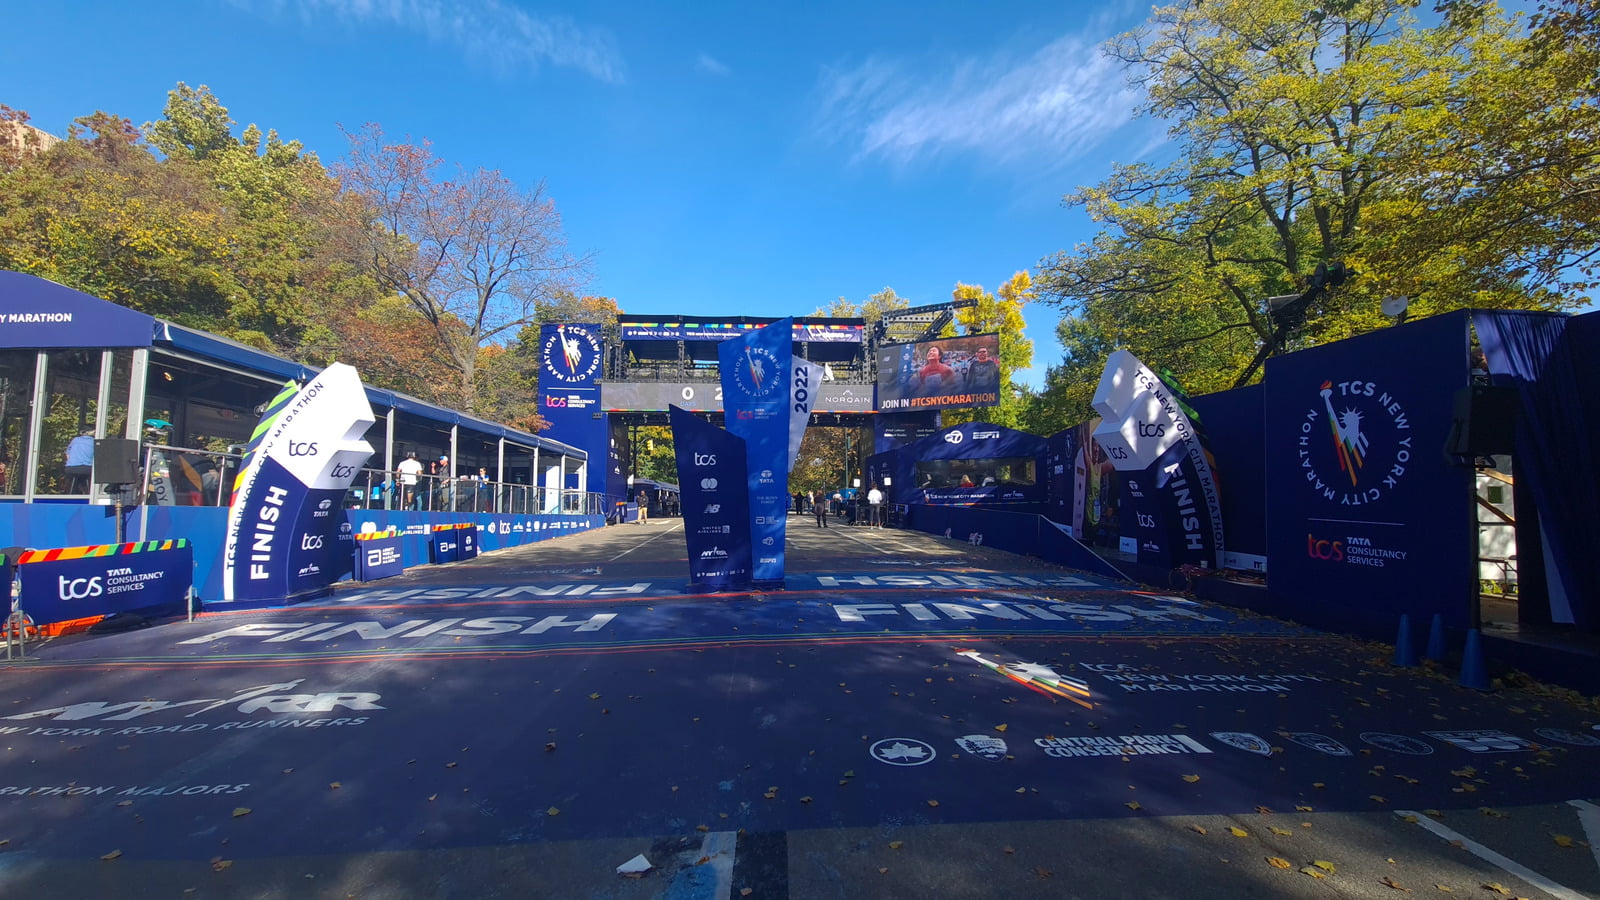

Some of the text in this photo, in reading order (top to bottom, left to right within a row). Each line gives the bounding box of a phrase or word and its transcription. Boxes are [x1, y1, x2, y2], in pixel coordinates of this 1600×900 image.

[8, 313, 72, 323] MARATHON
[567, 326, 587, 336] TCS
[586, 334, 600, 351] NEW
[543, 336, 565, 380] MARATHON
[753, 348, 769, 356] TCS
[585, 353, 601, 376] YORK
[566, 374, 586, 382] CITY
[681, 386, 694, 400] 0
[795, 366, 809, 414] 2022
[545, 394, 567, 408] tcs
[881, 392, 996, 409] JOIN IN #TCSNYCMARATHON
[972, 430, 1000, 440] ESPN
[1138, 420, 1166, 438] tcs
[288, 439, 319, 457] tcs
[1298, 380, 1413, 505] TCS NEW YORK CITY MARATHON
[694, 451, 717, 466] tcs
[1106, 443, 1128, 461] tcs
[1134, 369, 1224, 551] TCS NEW YORK CITY MARATHON
[330, 462, 356, 479] tcs
[1163, 462, 1204, 551] FINISH
[499, 520, 511, 534] tcs
[1136, 511, 1156, 529] tcs
[250, 485, 289, 580] FINISH
[301, 532, 325, 551] tcs
[1307, 532, 1344, 562] tcs
[1346, 536, 1371, 547] TATA
[1346, 546, 1408, 560] CONSULTANCY
[1346, 555, 1385, 568] SERVICES
[106, 567, 132, 577] TATA
[107, 571, 164, 586] CONSULTANCY
[59, 575, 103, 601] tcs
[107, 582, 145, 595] SERVICES
[816, 574, 1102, 587] FINISH
[337, 582, 653, 602] FINISH
[832, 602, 1225, 623] FINISH
[177, 612, 619, 645] FINISH
[1079, 662, 1140, 672] tcs
[1103, 674, 1326, 682] NEW YORK CITY
[1119, 683, 1292, 693] MARATHON
[27, 727, 115, 736] YORK
[112, 723, 209, 736] ROAD
[217, 716, 371, 730] RUNNERS
[1034, 734, 1182, 748] CENTRAL PARK
[0, 783, 252, 797] RATHON MAJORS
